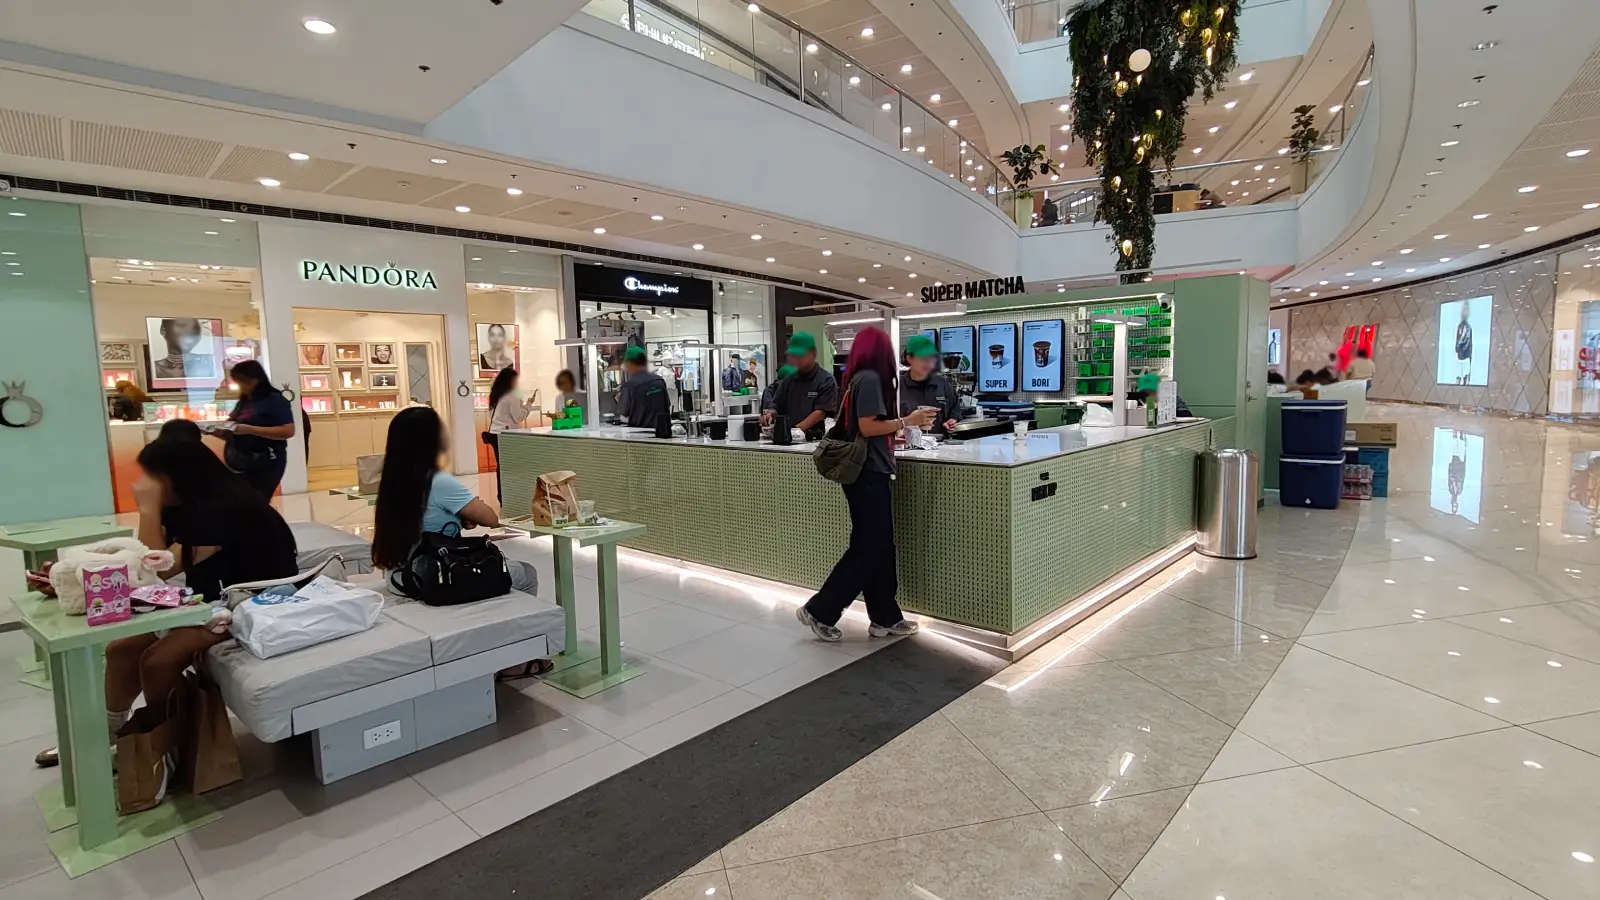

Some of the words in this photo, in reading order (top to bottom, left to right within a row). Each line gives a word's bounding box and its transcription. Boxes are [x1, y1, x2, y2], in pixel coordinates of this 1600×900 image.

[302, 260, 438, 290] PANDORA
[624, 277, 680, 296] Champion
[920, 283, 963, 303] SUPER
[965, 275, 1025, 299] MATCHA
[985, 379, 1008, 388] SUPER
[1031, 378, 1050, 388] BORI
